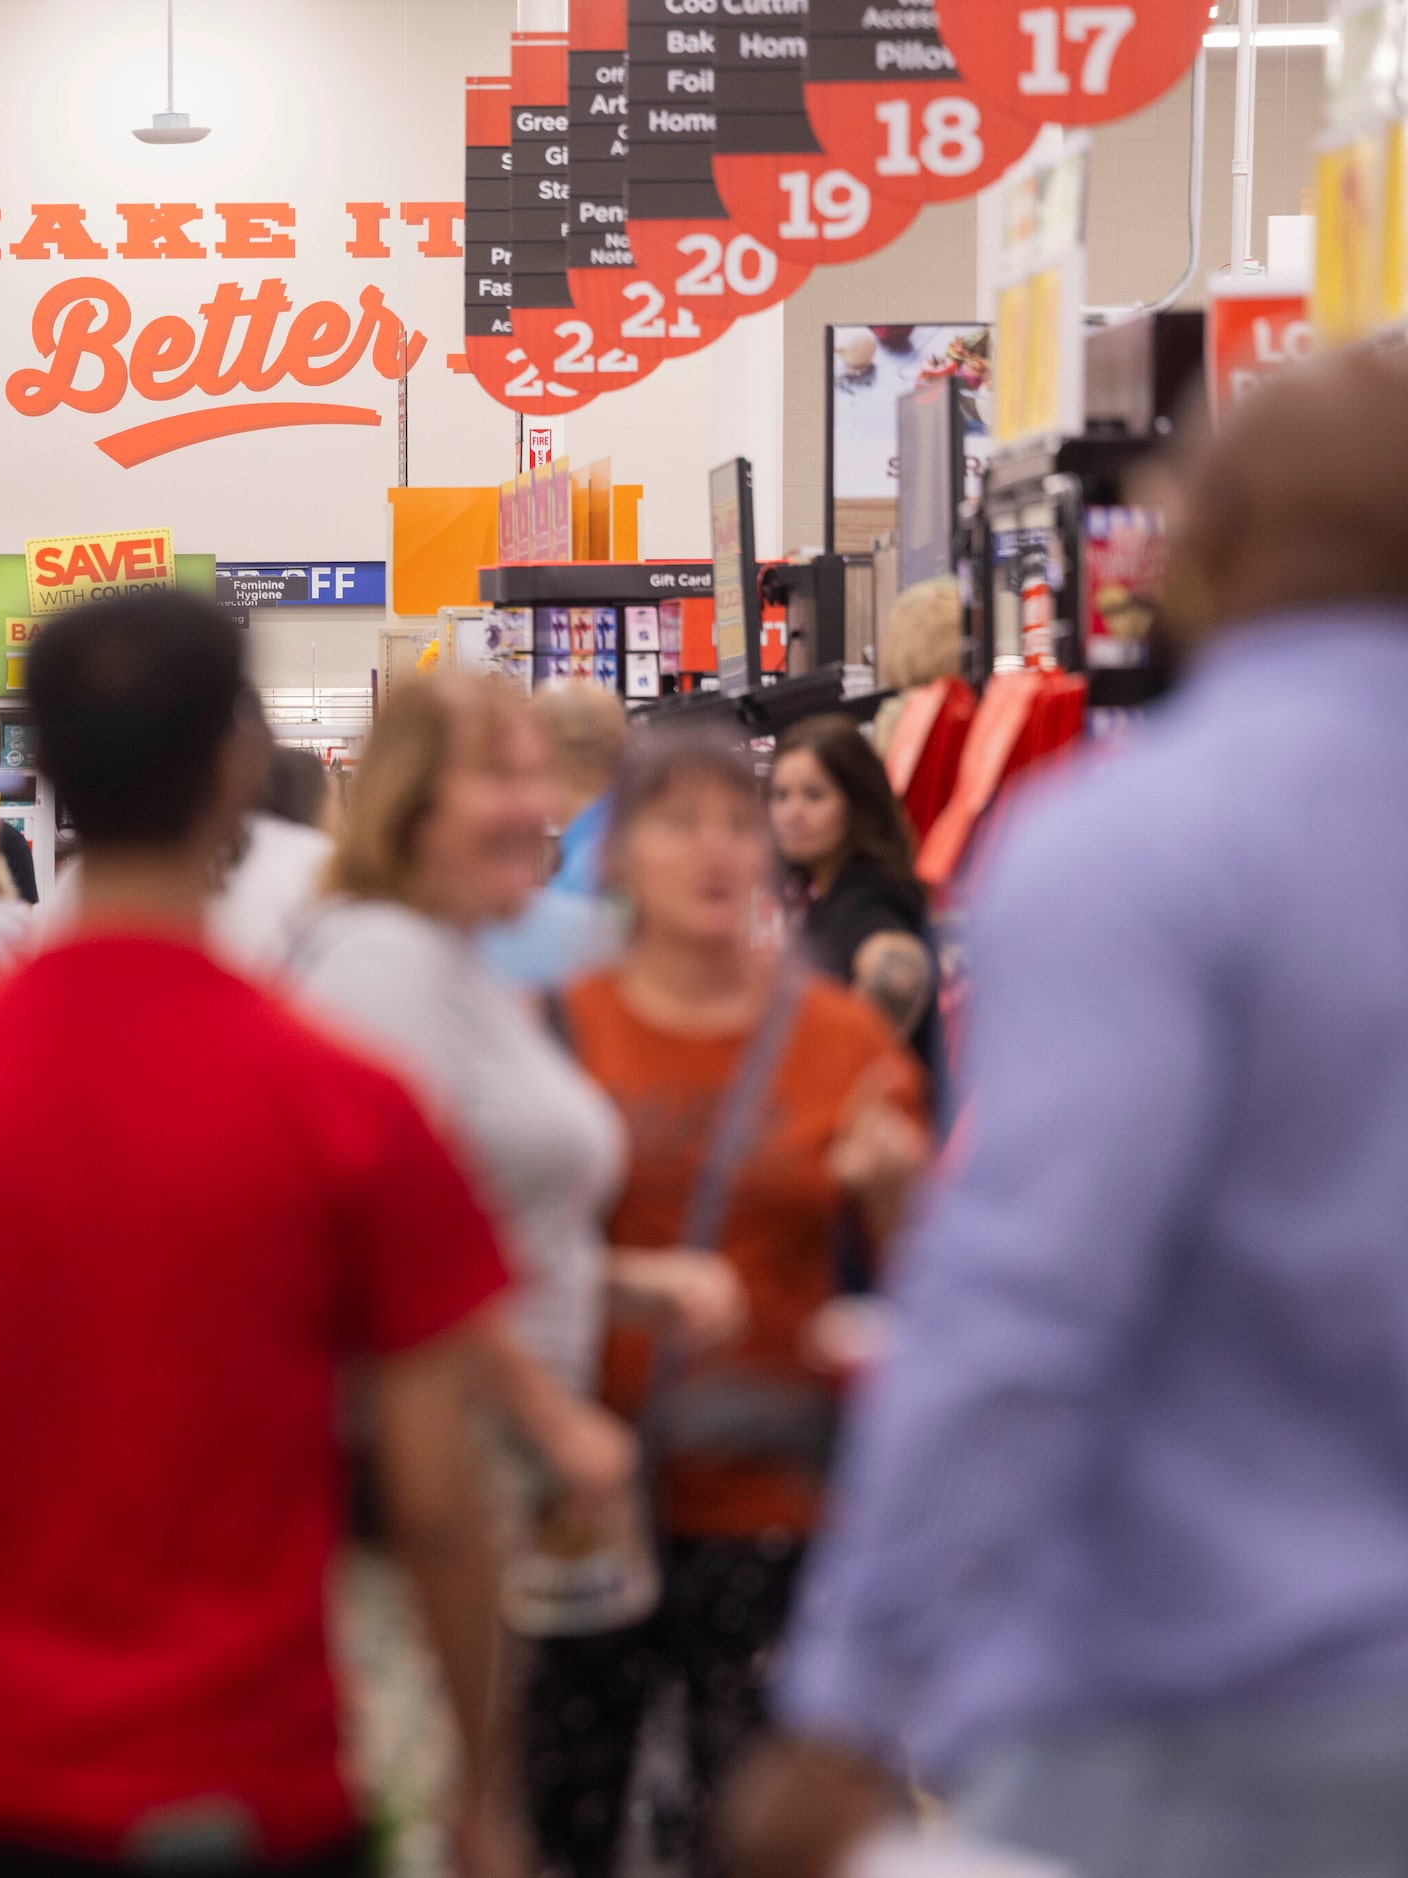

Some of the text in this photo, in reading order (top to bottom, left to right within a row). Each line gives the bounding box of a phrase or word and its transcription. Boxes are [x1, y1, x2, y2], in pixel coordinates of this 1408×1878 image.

[1018, 6, 1135, 96] 17
[667, 68, 715, 93] Foil
[874, 97, 984, 178] 18
[778, 169, 872, 240] 19
[675, 233, 778, 296] 20
[5, 276, 428, 417] Better
[532, 436, 549, 446] FIRE
[34, 537, 168, 588] SAVE!
[649, 573, 712, 587] Gift Card
[39, 581, 167, 606] WITH COUPON
[233, 580, 286, 590] Feminine
[236, 590, 283, 601] Hygiene
